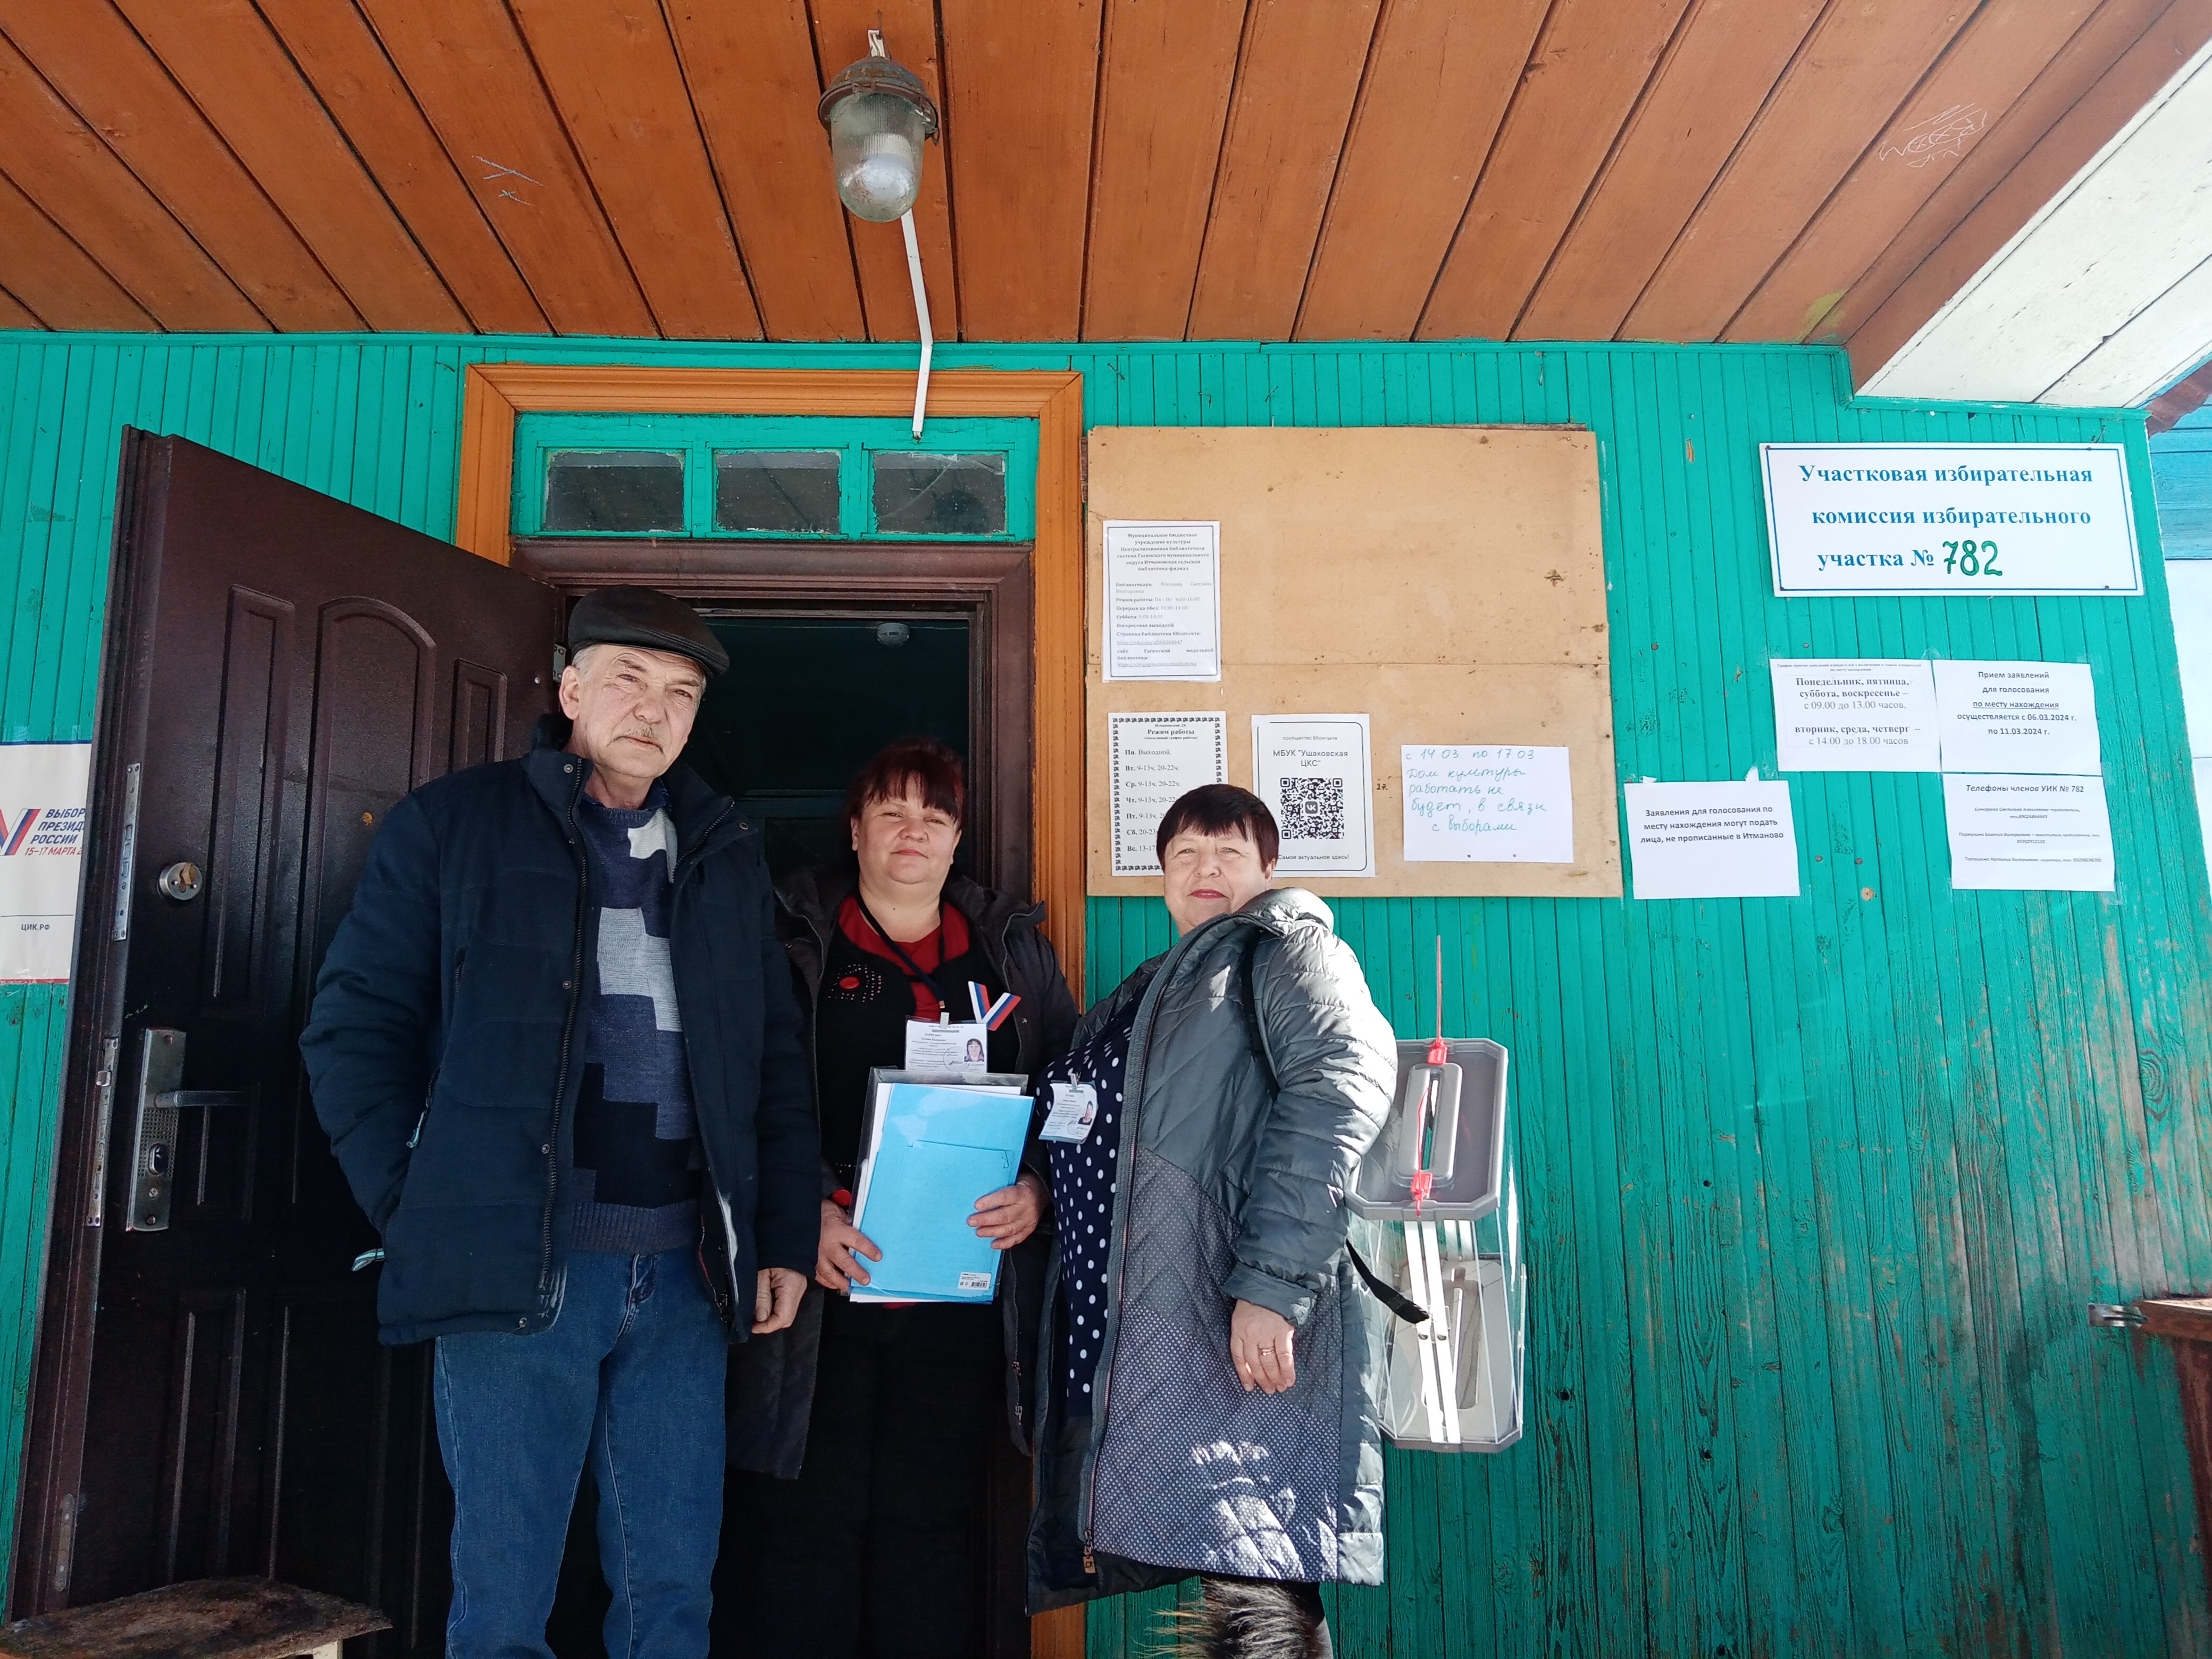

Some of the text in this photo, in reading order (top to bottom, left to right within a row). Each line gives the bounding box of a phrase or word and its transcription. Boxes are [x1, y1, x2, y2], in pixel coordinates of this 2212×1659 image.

[1798, 465, 2092, 485] Участковая избирательная
[1812, 507, 2090, 528] комиссия избирательного
[1817, 540, 2002, 576] участка № 782
[1800, 690, 1839, 699] суббота,
[1407, 767, 1526, 782] Дом культуры
[1409, 783, 1481, 797] работать
[45, 808, 86, 818] ВЫБОР
[1478, 798, 1486, 811] в
[1497, 798, 1546, 815] связи
[37, 821, 85, 832] ПРЕЗИД
[30, 834, 78, 844] РОССИИ
